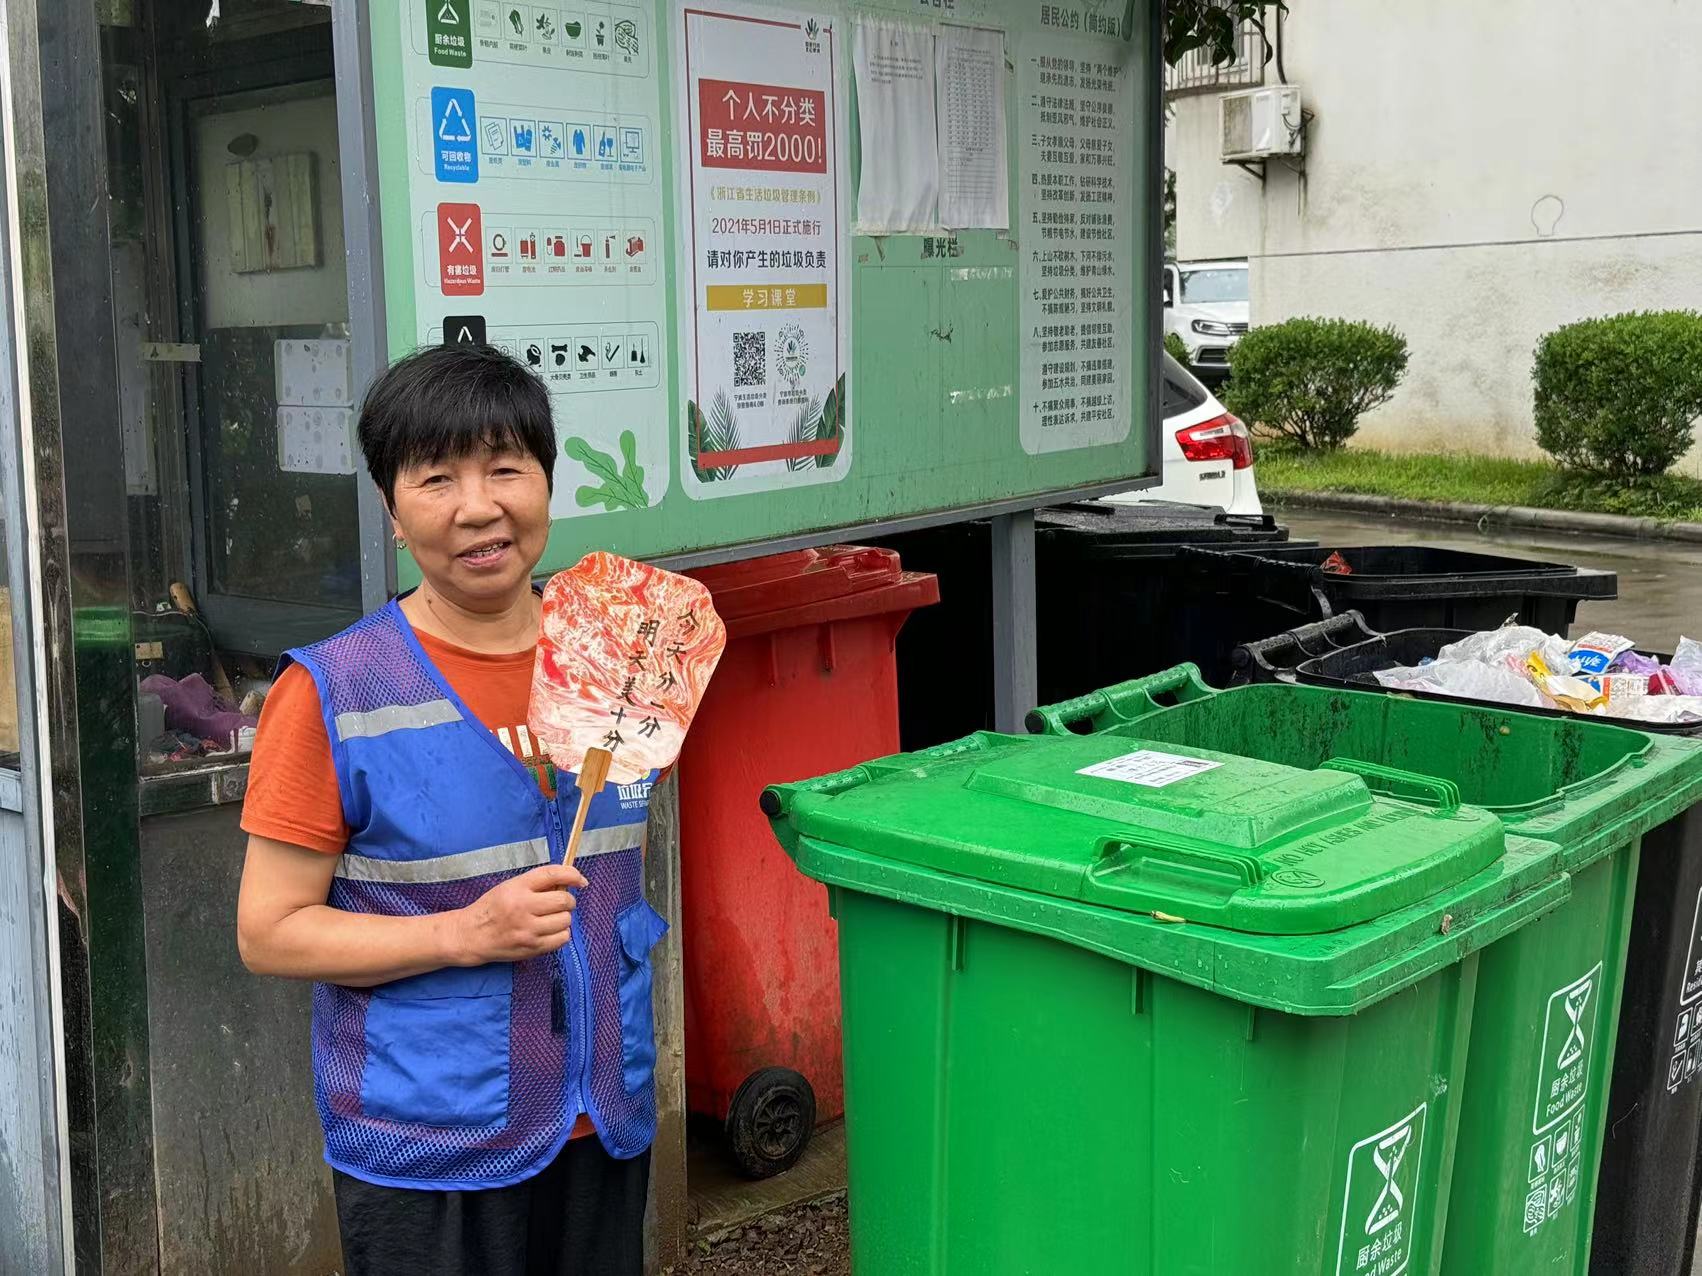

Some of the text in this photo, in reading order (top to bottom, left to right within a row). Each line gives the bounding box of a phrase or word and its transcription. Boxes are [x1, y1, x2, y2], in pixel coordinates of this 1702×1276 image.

[434, 33, 465, 47] 厨余垃圾
[434, 47, 467, 57] Food Waste
[722, 89, 816, 126] 个人不分类
[441, 150, 471, 162] 可回收物
[710, 186, 822, 204] 《浙江省生活垃圾管理条例》
[712, 218, 822, 236] 2021年5月1日正式施行
[923, 236, 958, 258] 曝光栏
[707, 250, 827, 269] 请对你产生的垃圾负责
[447, 264, 477, 276] 有害垃圾
[743, 289, 796, 308] 学习课堂
[602, 619, 660, 752] 明天美十分
[620, 800, 640, 810] WASTE
[1550, 1058, 1584, 1099] 厨余垃圾
[1546, 1082, 1583, 1117] Food Waste
[1356, 1221, 1402, 1271] 厨余垃圾
[1378, 1248, 1402, 1276] Waste
